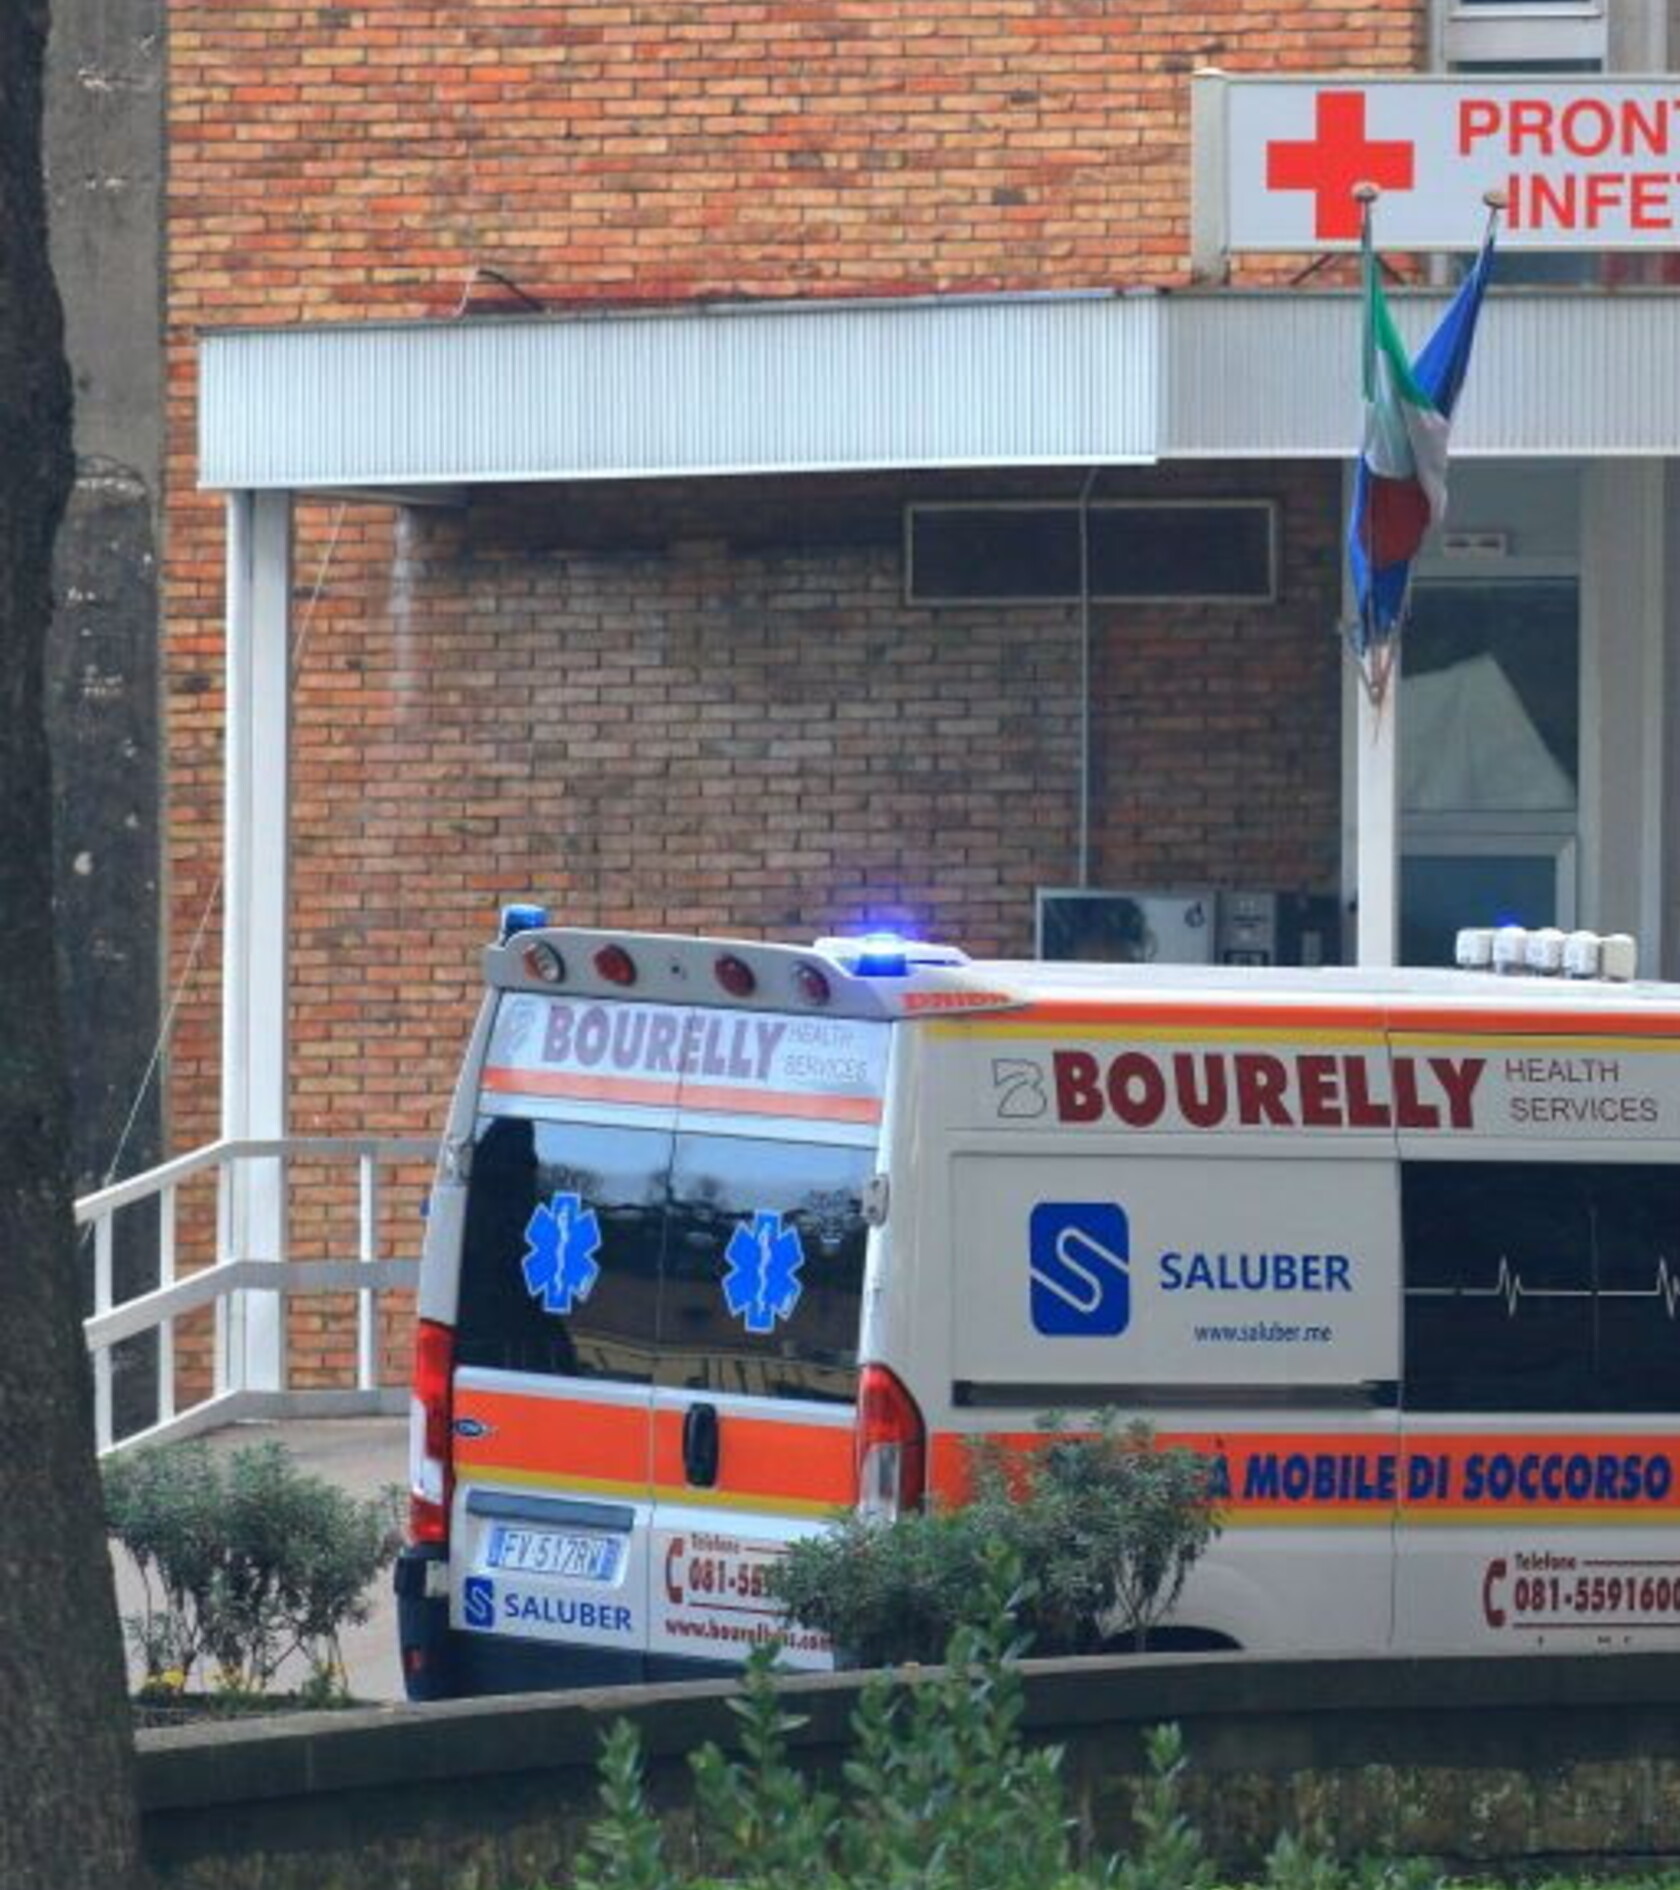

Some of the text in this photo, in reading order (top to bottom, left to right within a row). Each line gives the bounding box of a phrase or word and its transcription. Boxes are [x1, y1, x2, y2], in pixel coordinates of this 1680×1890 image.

[541, 1003, 788, 1081] BOURELLY
[788, 1024, 856, 1046] HEALTH
[783, 1054, 871, 1083] SERVICES
[1504, 1057, 1621, 1083] HEALTH
[1052, 1048, 1488, 1130] BOURELLY
[1509, 1096, 1659, 1123] SERVICES
[1159, 1251, 1353, 1292] SALUBER
[1193, 1321, 1332, 1343] www.saluber.me
[1243, 1452, 1396, 1501] MOBILE
[1407, 1453, 1450, 1501] DI
[1463, 1453, 1672, 1501] SOCCORSO
[503, 1593, 633, 1632] SALUBER
